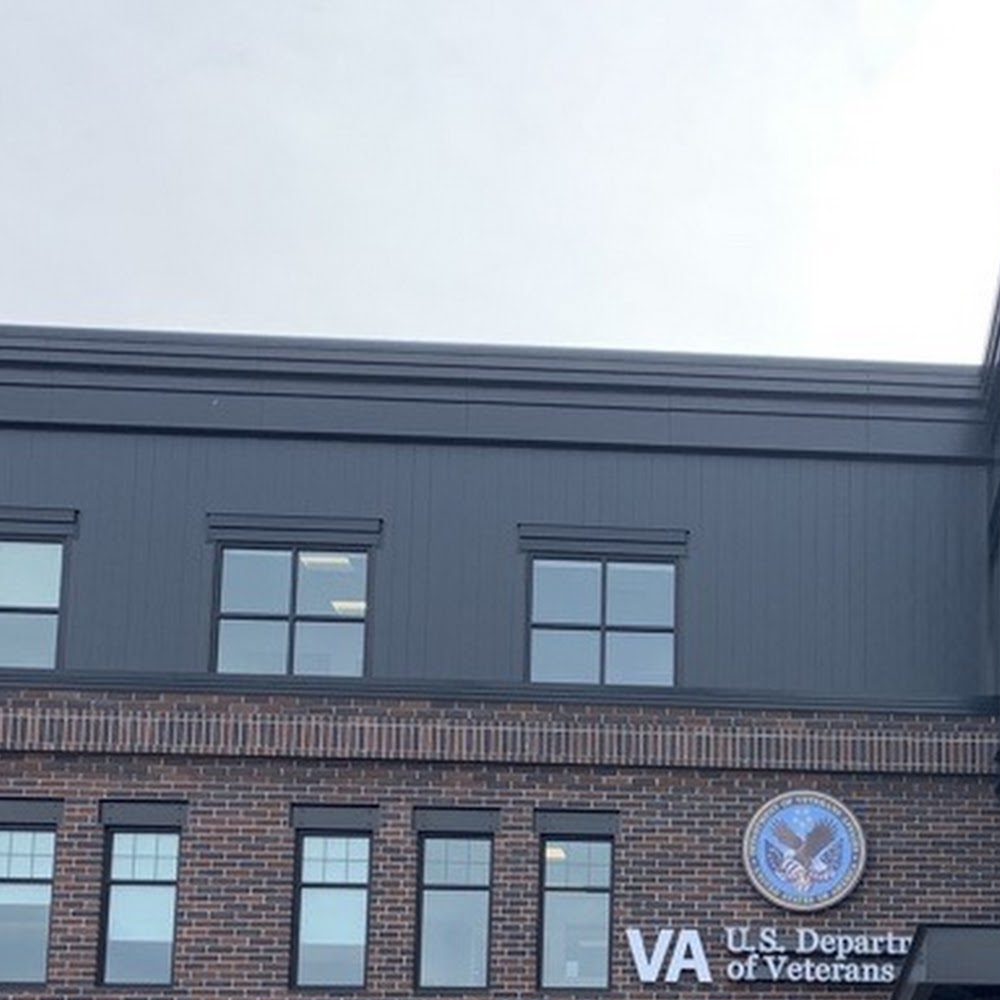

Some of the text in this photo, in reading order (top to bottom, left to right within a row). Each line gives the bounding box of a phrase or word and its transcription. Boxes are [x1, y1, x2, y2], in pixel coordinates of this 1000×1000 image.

[725, 926, 786, 953] U.S.
[626, 928, 713, 983] VA
[727, 955, 896, 983] of Veterans
